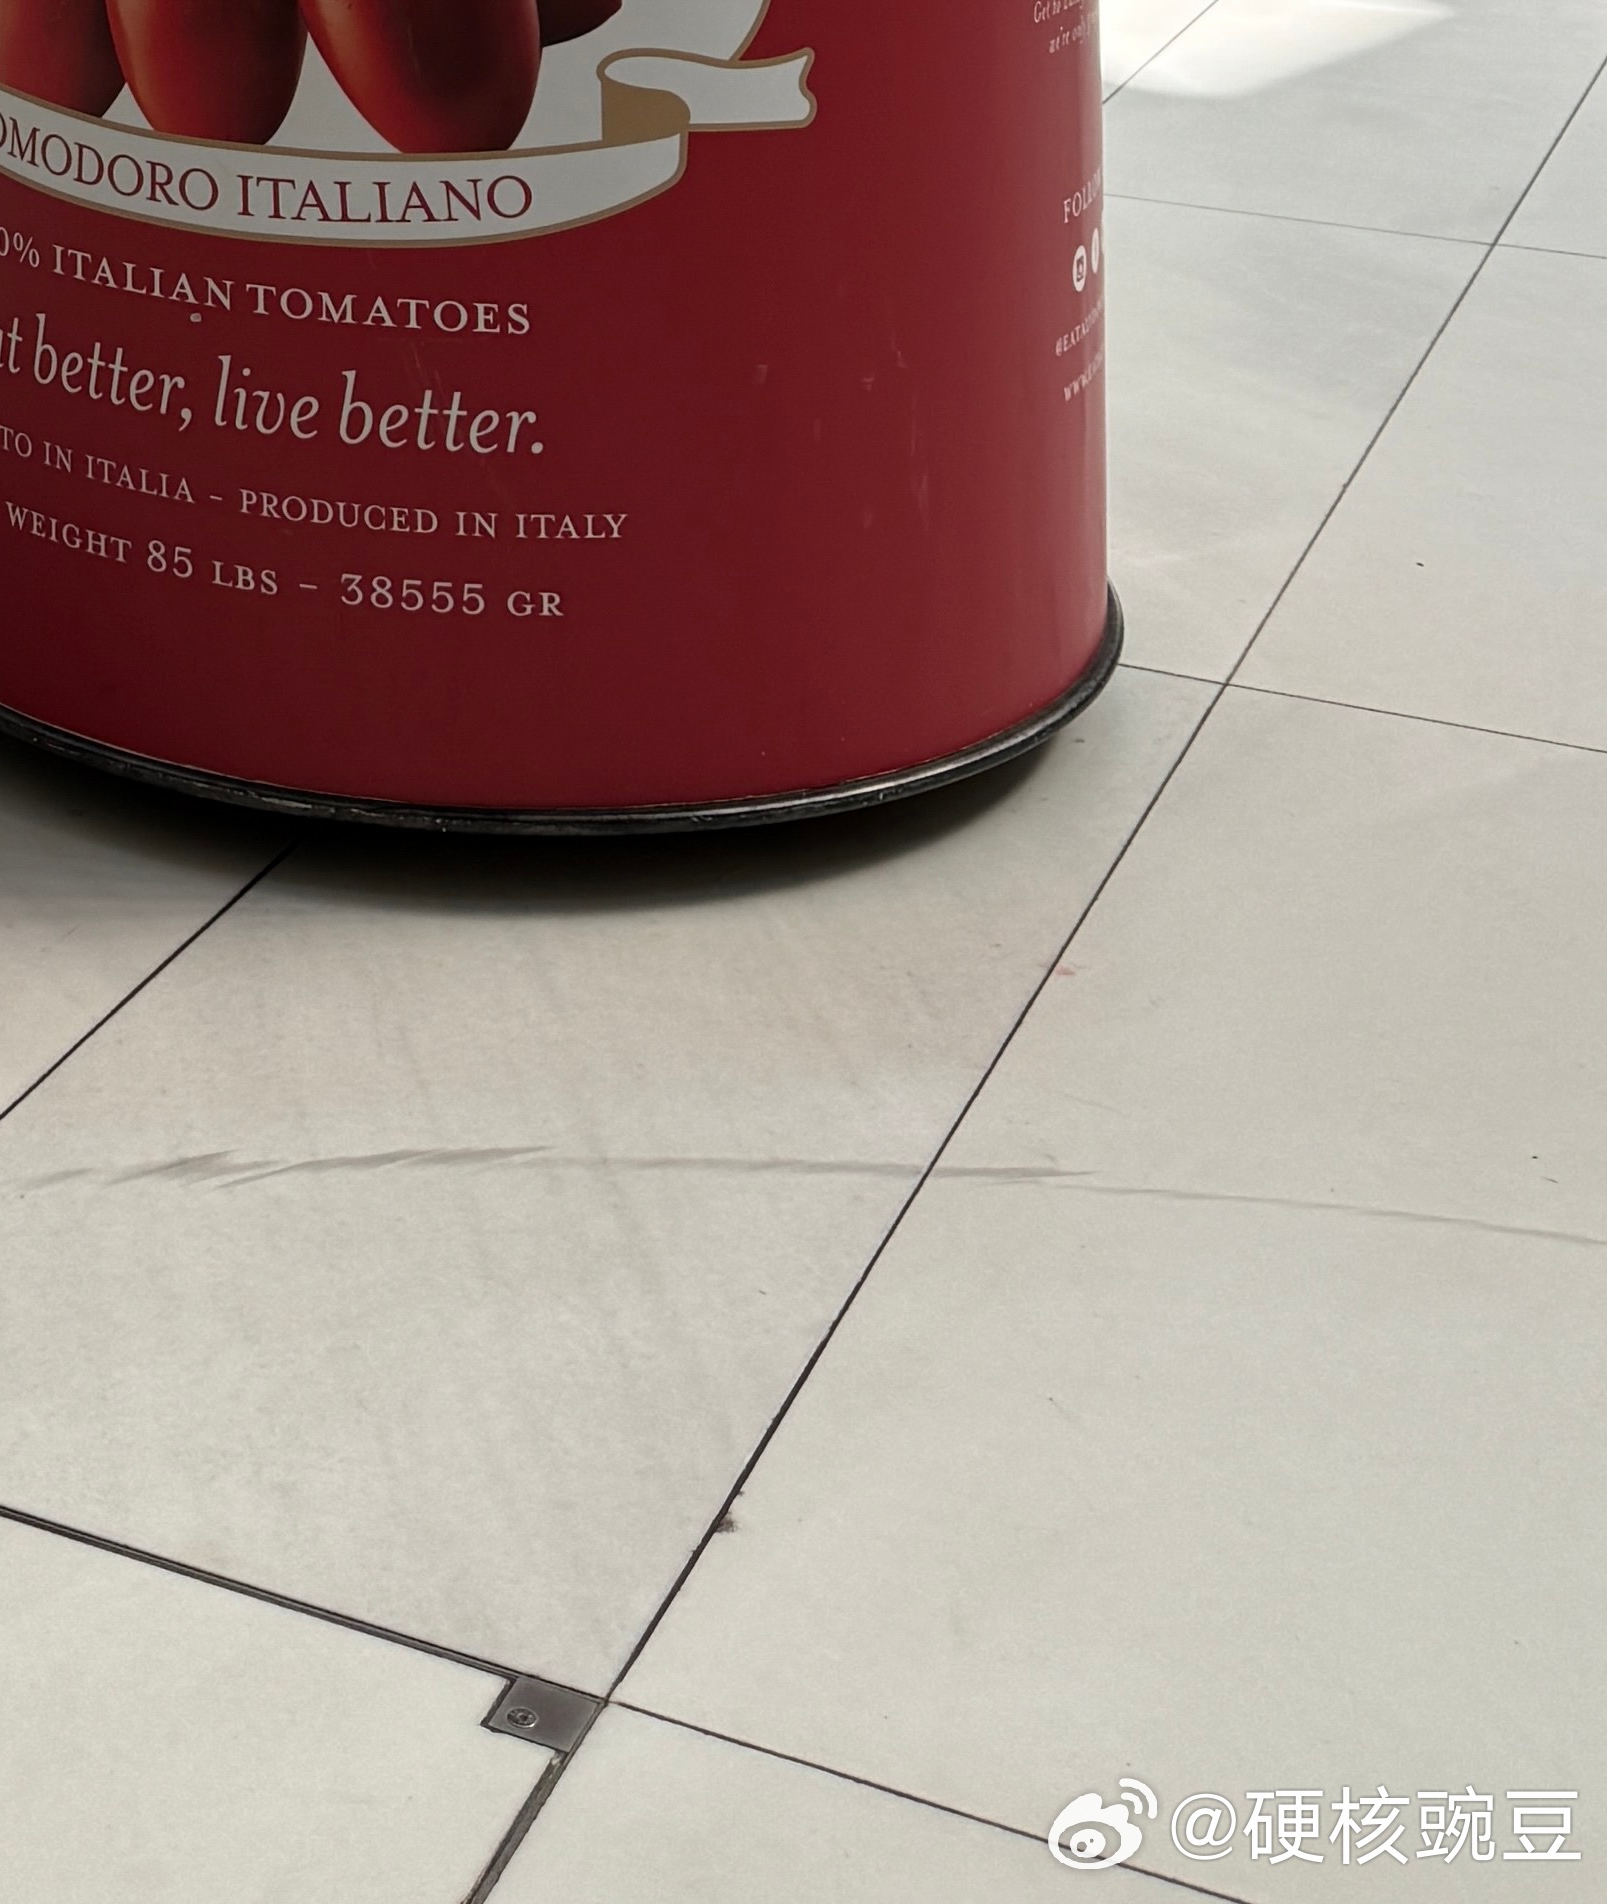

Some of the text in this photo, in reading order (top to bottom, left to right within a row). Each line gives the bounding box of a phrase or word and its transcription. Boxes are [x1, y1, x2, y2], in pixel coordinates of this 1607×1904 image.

[236, 174, 533, 223] ITALIANO
[52, 245, 234, 310] ITALIAN
[245, 283, 531, 335] TOMATOES
[34, 313, 194, 431] better,
[214, 355, 319, 438] live
[340, 370, 545, 454] better.
[43, 441, 73, 474] IN
[85, 453, 195, 503] ITALIA
[239, 488, 438, 534] PRODUCED
[455, 511, 498, 538] IN
[515, 513, 627, 539] ITALY
[5, 501, 132, 563] WEIGHT
[146, 539, 193, 578] 85
[212, 561, 278, 595] LBS
[341, 573, 485, 616] 38555
[506, 590, 564, 617] GR
